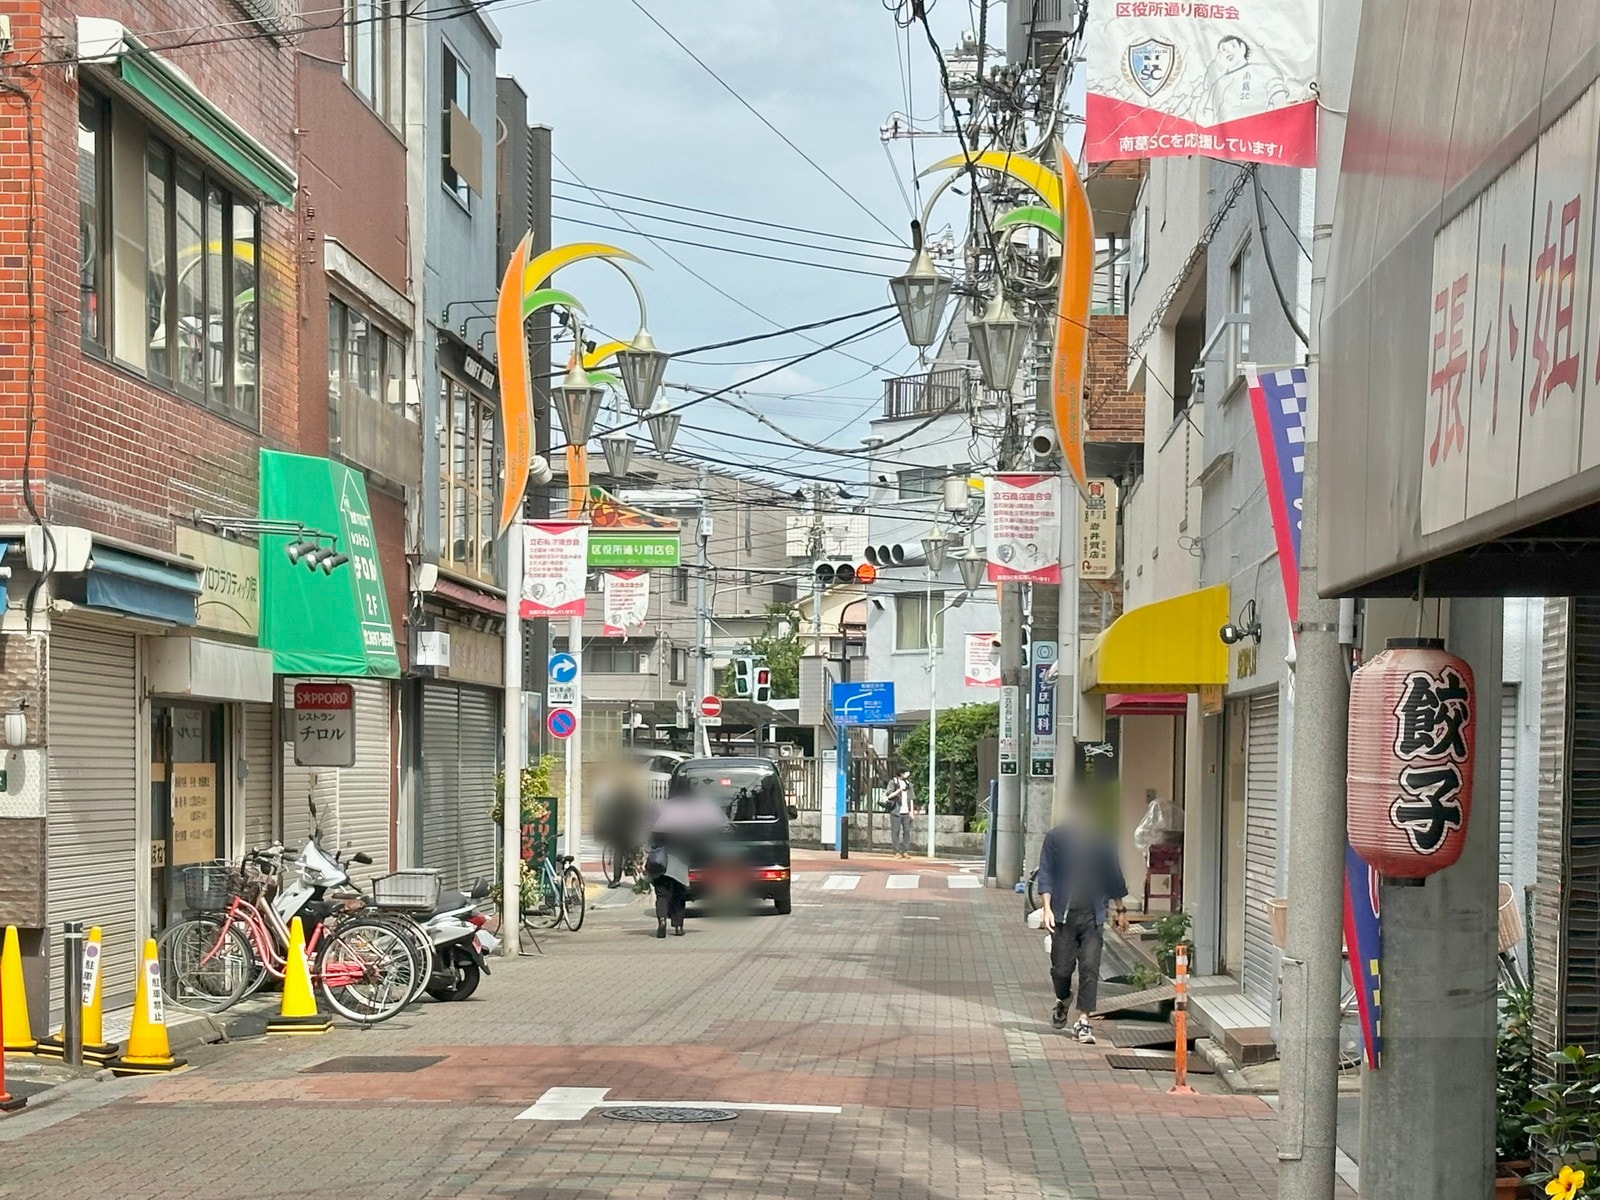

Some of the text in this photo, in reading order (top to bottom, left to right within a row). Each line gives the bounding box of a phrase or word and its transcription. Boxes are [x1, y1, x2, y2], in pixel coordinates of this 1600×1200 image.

[1116, 2, 1240, 20] 区役所通り商店会
[591, 544, 675, 556] 区役所通り商店会
[298, 712, 336, 721] レストラン
[299, 726, 347, 742] チロル
[1388, 665, 1471, 855] 餃子
[151, 977, 162, 1021] 駐車禁止
